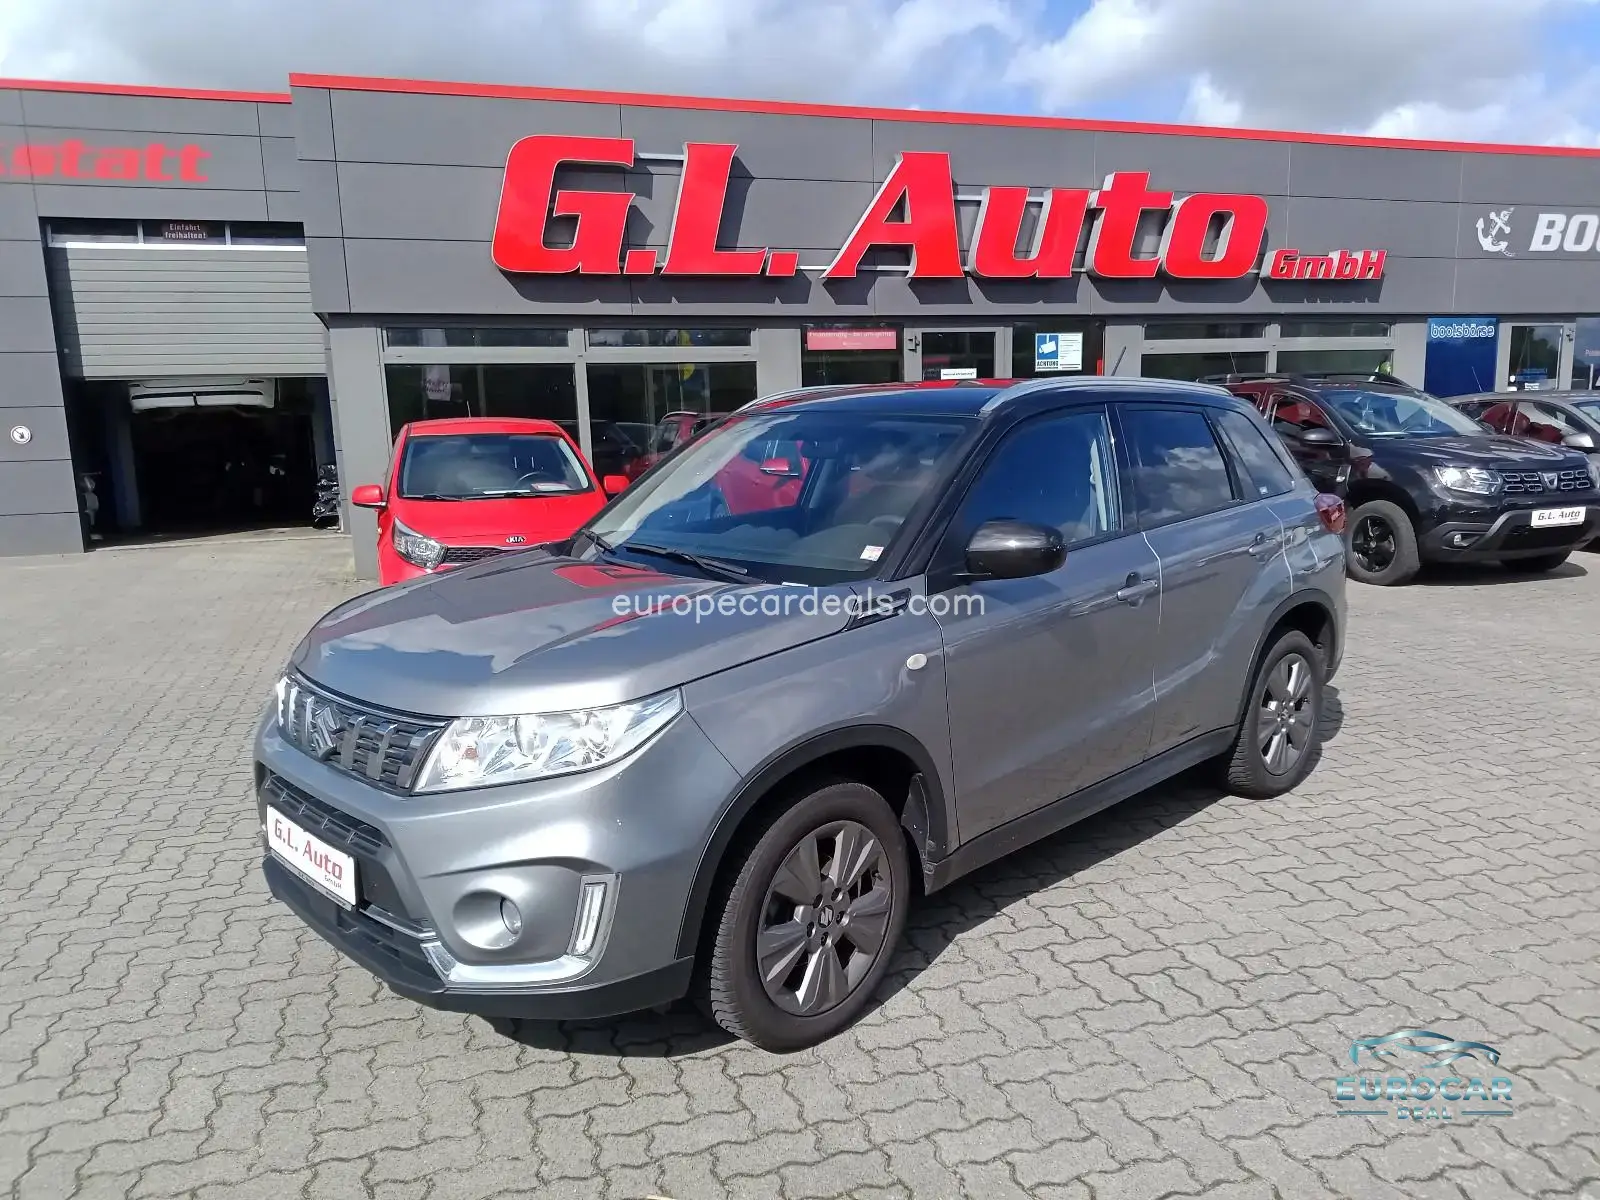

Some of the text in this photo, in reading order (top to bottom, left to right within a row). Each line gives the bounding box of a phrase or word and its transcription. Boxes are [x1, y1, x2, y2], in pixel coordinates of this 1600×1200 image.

[0, 138, 212, 182] statt
[169, 223, 201, 231] Einfahrt
[491, 134, 1388, 280] G.L. Auto GmbH
[1529, 213, 1600, 252] BO
[1559, 510, 1581, 519] Auto
[274, 818, 343, 881] G.L. Auto
